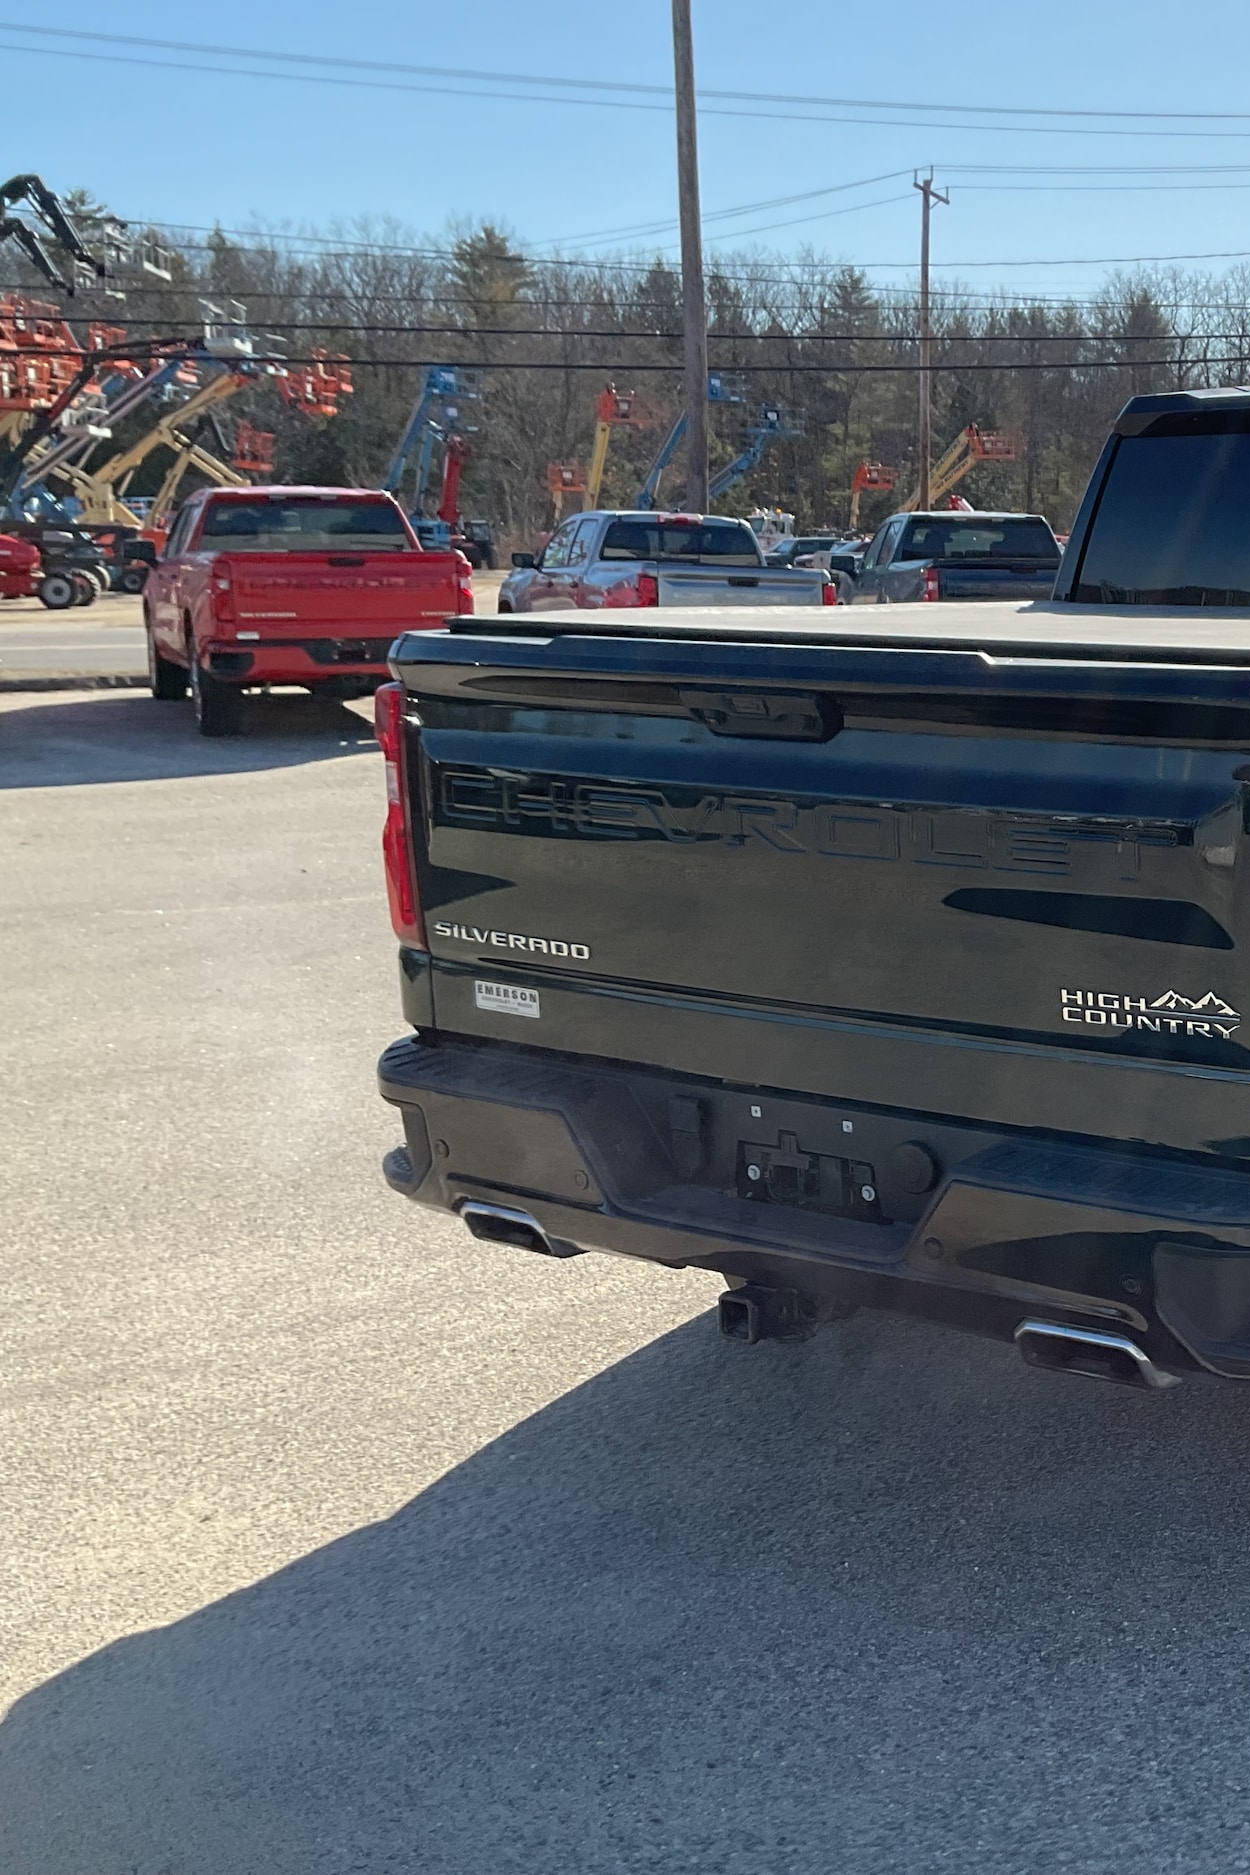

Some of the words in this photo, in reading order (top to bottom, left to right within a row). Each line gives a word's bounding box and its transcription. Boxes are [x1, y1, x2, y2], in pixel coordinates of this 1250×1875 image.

[440, 772, 1178, 881] CHEVROLET
[433, 920, 591, 960] SILVERADO
[477, 984, 537, 1003] EMERSON
[1061, 988, 1147, 1013] HIGH
[1062, 1006, 1241, 1040] COUNTRY
